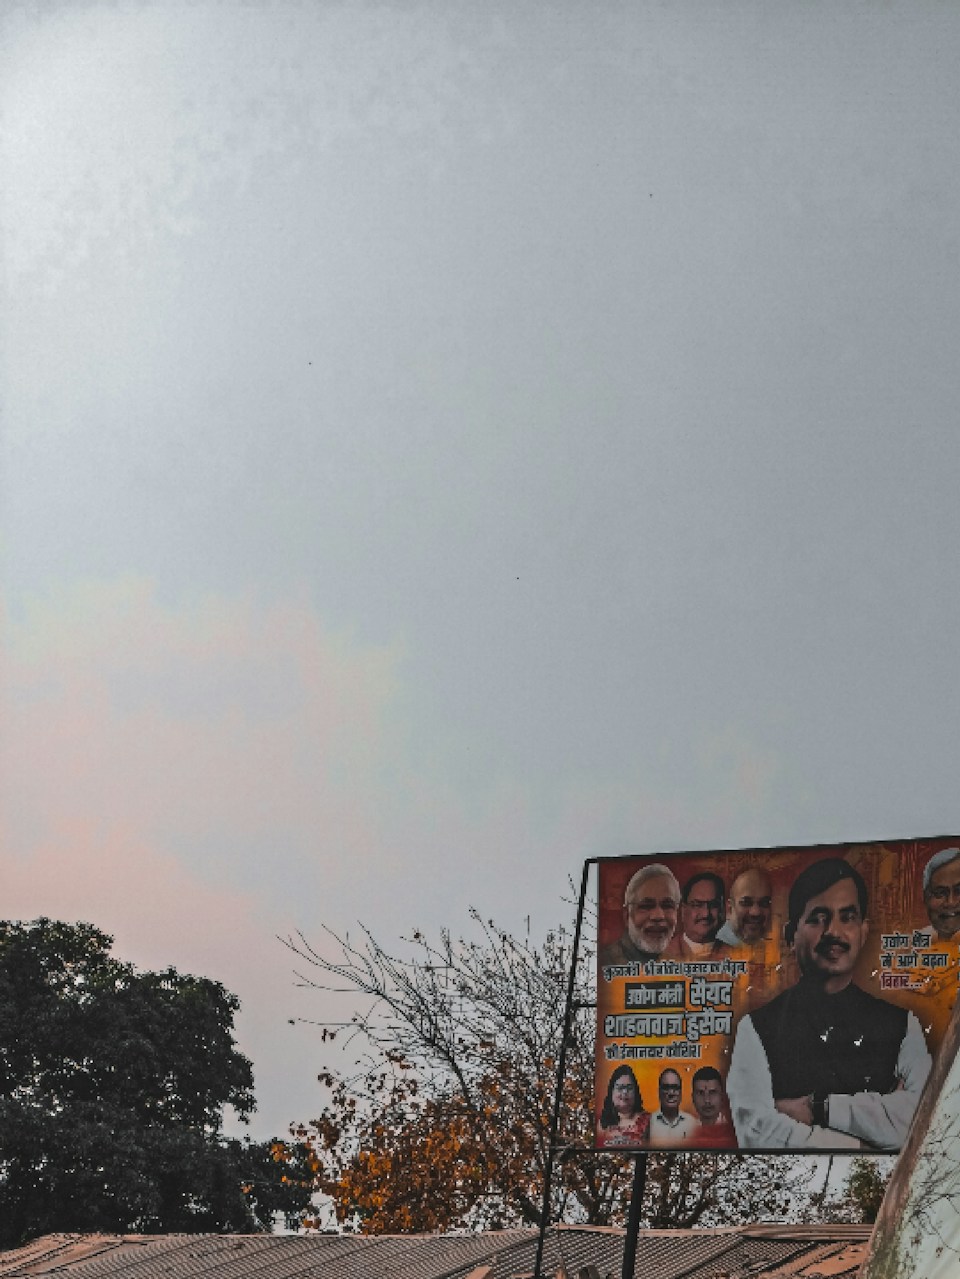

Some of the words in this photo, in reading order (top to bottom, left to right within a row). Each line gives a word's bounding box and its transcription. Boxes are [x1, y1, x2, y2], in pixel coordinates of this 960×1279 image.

[882, 932, 908, 950] उद्योग
[881, 952, 894, 968] में
[896, 951, 917, 968] आगे
[627, 985, 656, 1005] उद्योग
[657, 983, 683, 1004] मंत्री
[690, 977, 733, 1006] सैयद
[604, 1012, 683, 1037] शाहनवाज
[685, 1006, 733, 1041] हुसैन
